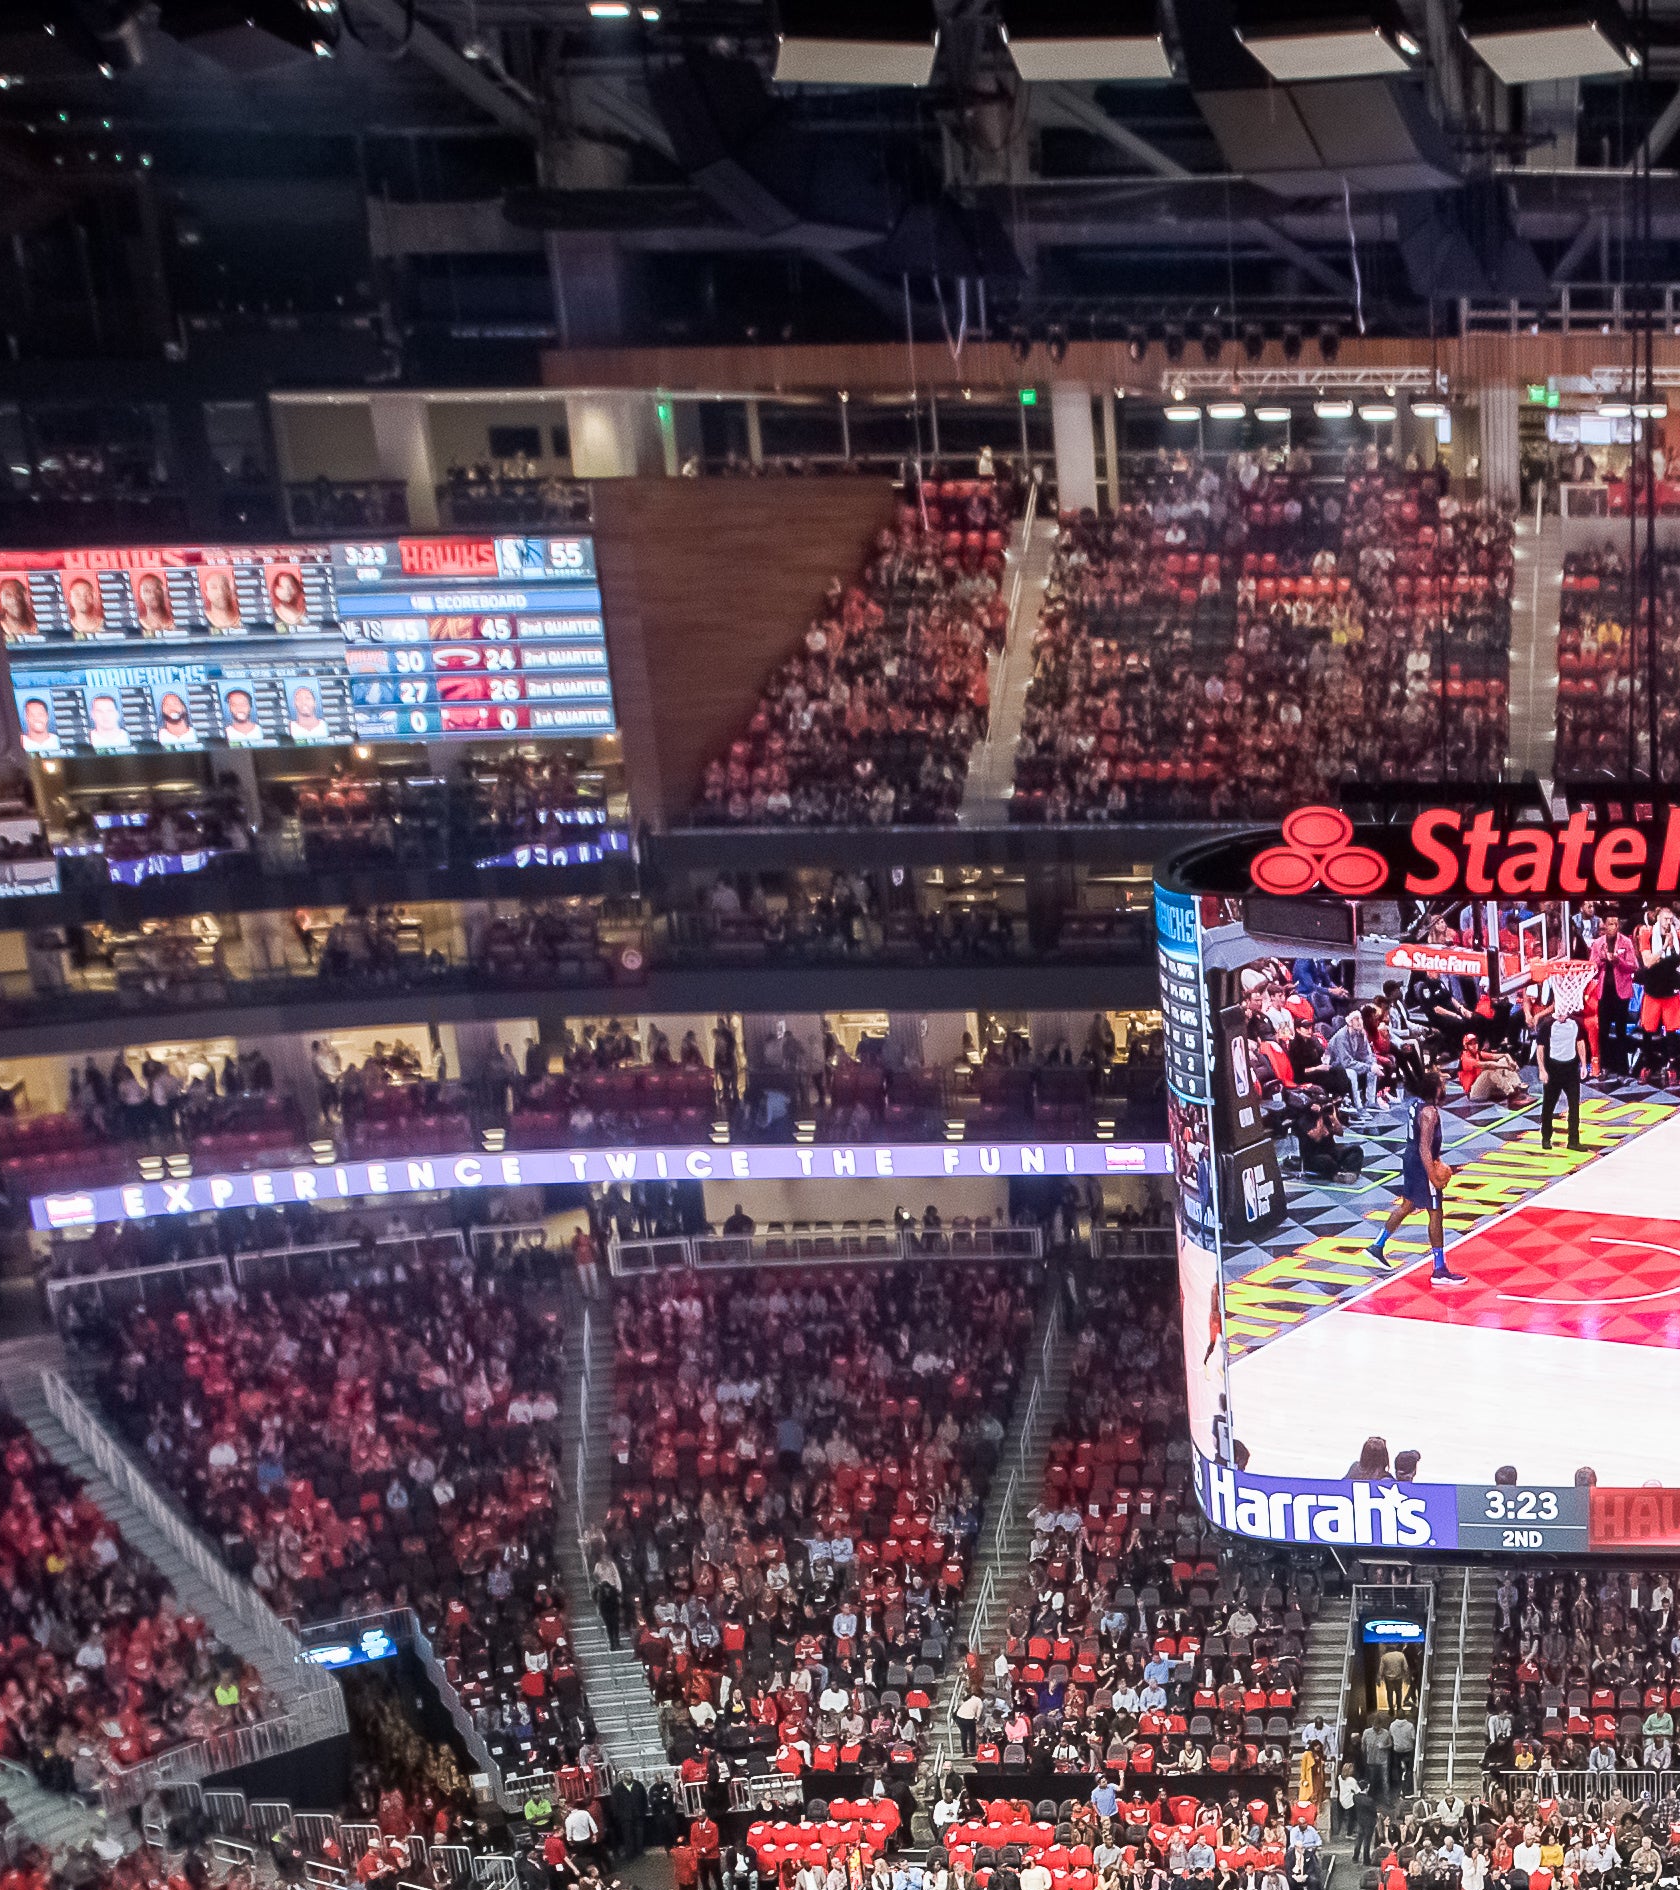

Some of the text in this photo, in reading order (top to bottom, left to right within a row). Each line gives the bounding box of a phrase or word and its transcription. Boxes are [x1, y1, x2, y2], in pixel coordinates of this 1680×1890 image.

[345, 546, 388, 567] 3:23
[401, 546, 494, 572] HAWKS
[550, 542, 584, 569] 55
[435, 594, 528, 610] SCOREBOARD
[480, 618, 512, 641] 45
[545, 617, 600, 635] QUARTER
[396, 650, 425, 673] 30
[484, 648, 517, 671] 24
[548, 649, 604, 667] QUARTER
[399, 681, 429, 704] 27
[488, 678, 520, 702] 26
[552, 679, 609, 697] QUARTER
[410, 710, 428, 733] 0
[499, 707, 517, 731] 0
[554, 708, 610, 725] QUARTER
[123, 1156, 522, 1218] EXPERIENCE
[569, 1150, 751, 1181] TWICE
[797, 1149, 894, 1177] THE
[1485, 1491, 1558, 1521] 3:23
[1502, 1530, 1543, 1548] 2ND
